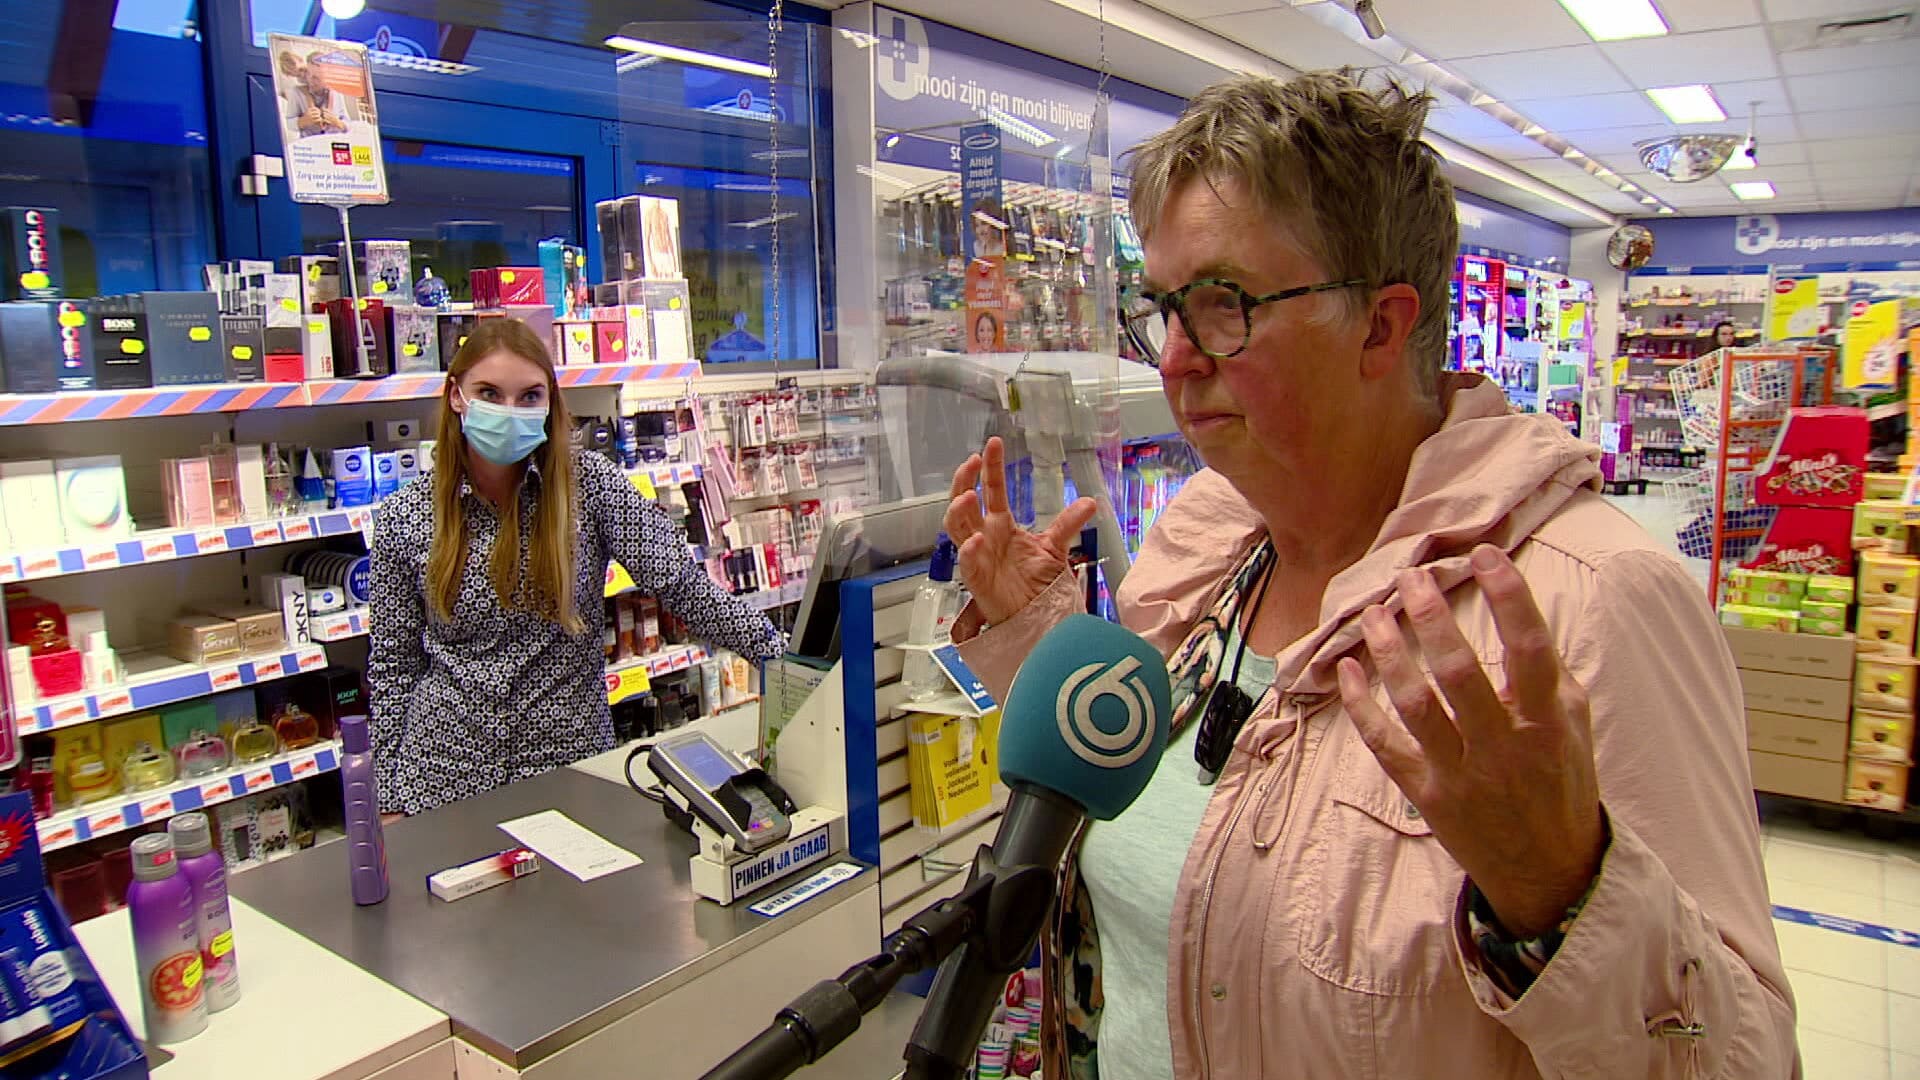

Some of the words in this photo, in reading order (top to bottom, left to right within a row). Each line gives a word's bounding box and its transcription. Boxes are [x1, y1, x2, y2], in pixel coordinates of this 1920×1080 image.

[913, 74, 956, 99] mooi
[960, 80, 985, 111] zijn
[990, 92, 1008, 112] en
[1013, 96, 1047, 121] mooi
[1050, 100, 1093, 130] blijven
[970, 155, 994, 168] Altijd
[970, 168, 993, 178] meer
[103, 318, 136, 328] BOSS
[224, 319, 259, 330] ETERNITY
[293, 590, 309, 644] DKNY
[243, 626, 280, 640] DKNY
[202, 635, 236, 649] DKNY
[948, 781, 980, 799] Nederland
[735, 857, 775, 889] PINNEN
[777, 850, 790, 870] JA
[793, 834, 827, 862] GRAAG
[22, 909, 49, 951] Labello
